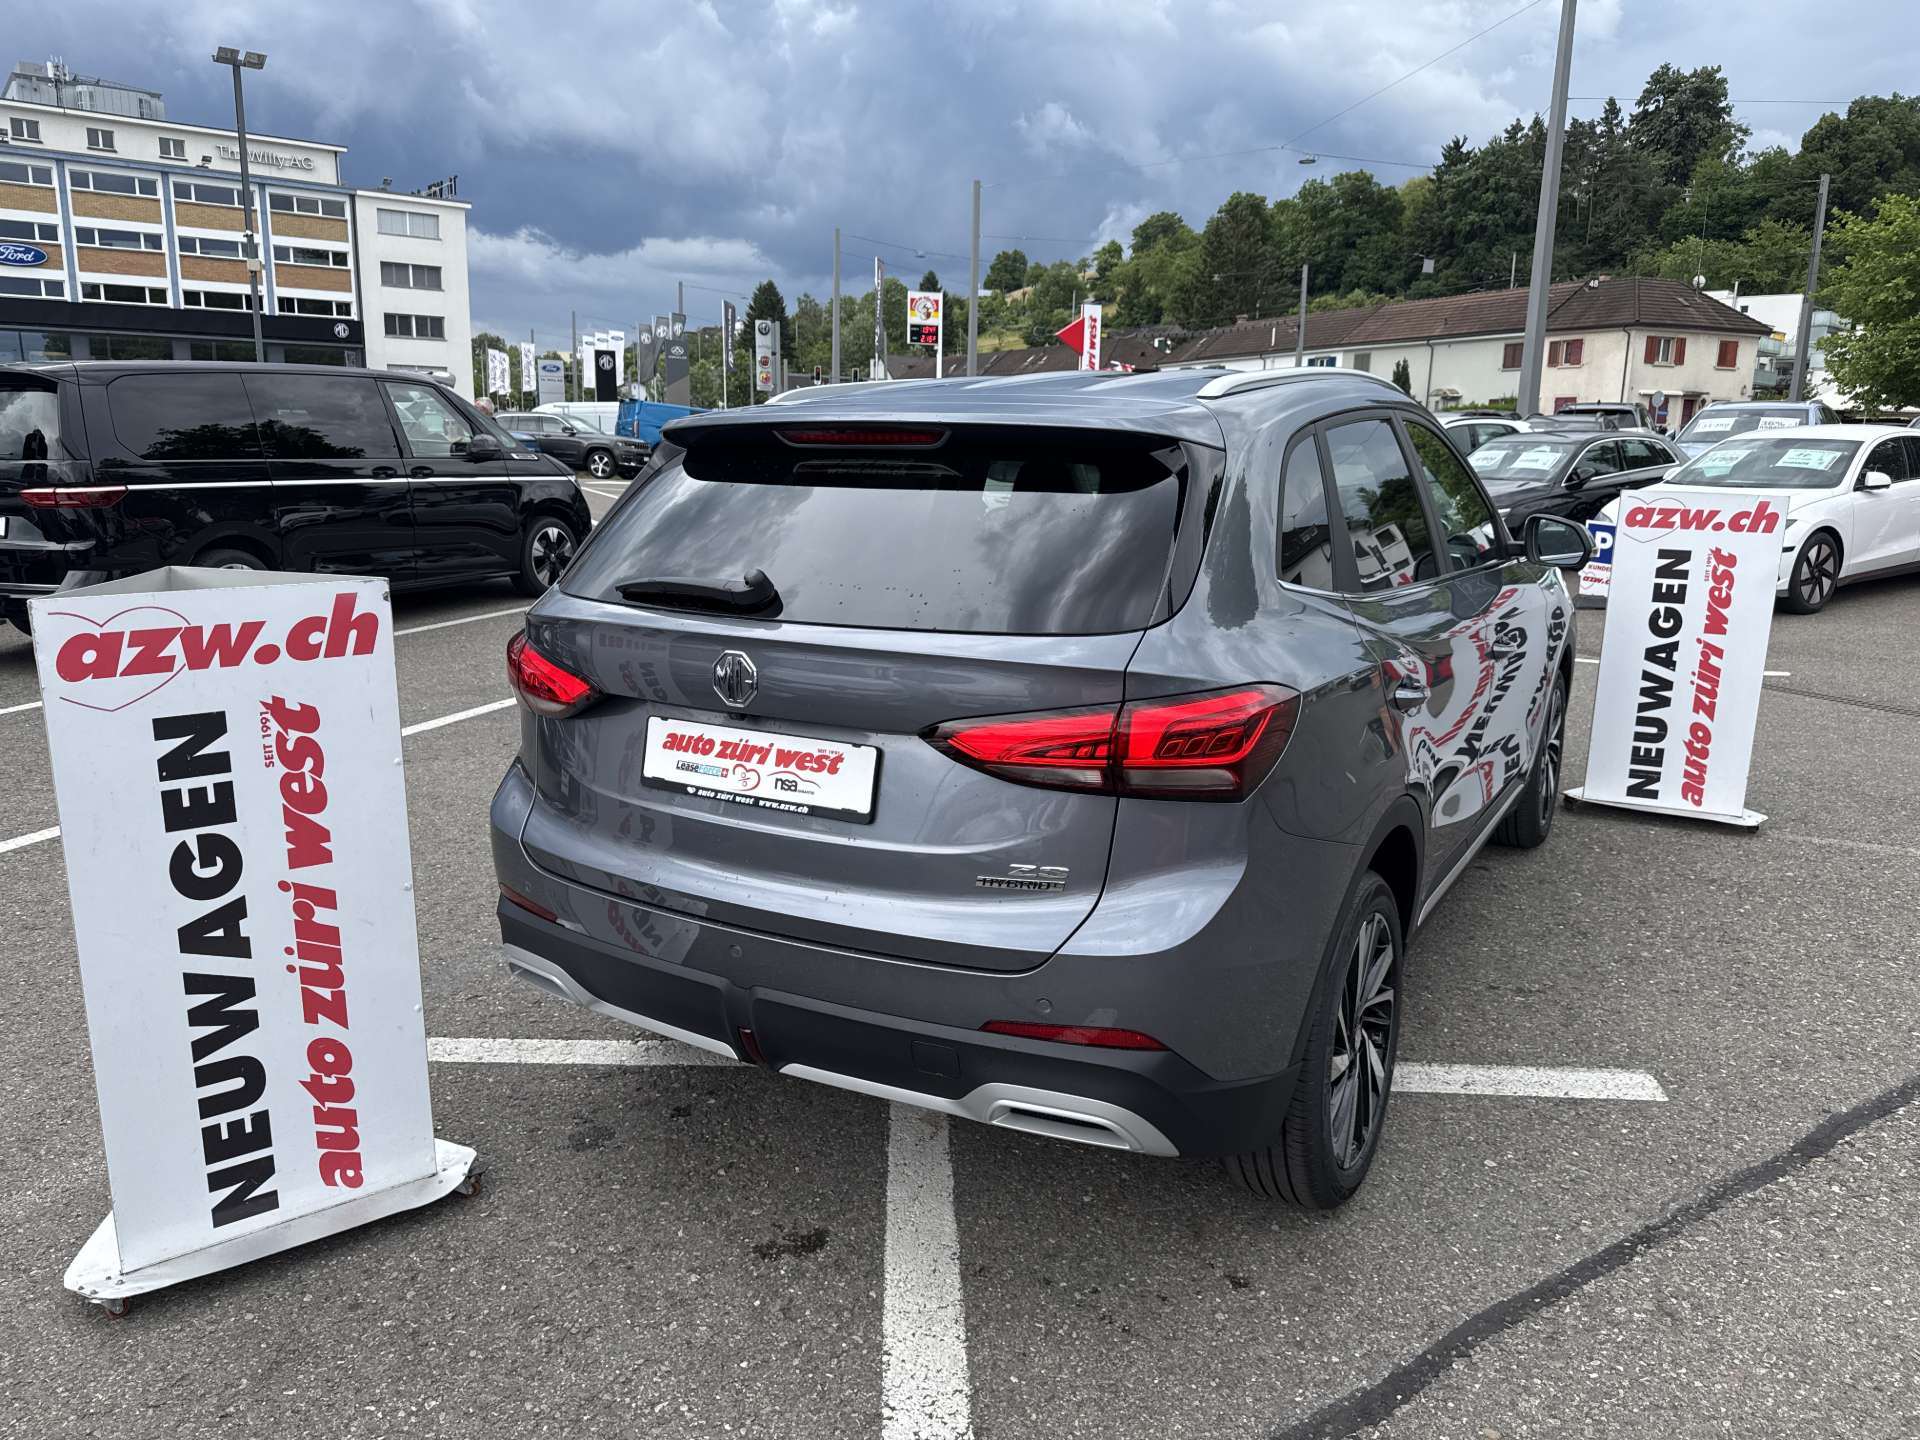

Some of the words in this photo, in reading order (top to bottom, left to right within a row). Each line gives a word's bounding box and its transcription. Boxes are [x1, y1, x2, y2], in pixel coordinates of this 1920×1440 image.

[290, 153, 314, 170] AG
[0, 245, 35, 261] Ford
[334, 323, 350, 338] MG
[599, 354, 614, 370] MG
[1625, 501, 1780, 534] azw.ch
[1594, 531, 1613, 557] P
[1583, 576, 1610, 584] azw.c
[1588, 564, 1612, 572] KUNDE
[1703, 546, 1738, 636] west
[56, 592, 379, 682] azw.ch
[715, 655, 753, 702] MG
[1626, 548, 1692, 800] NEUWAGEN
[1690, 637, 1724, 723] züri
[259, 711, 271, 739] 1991
[263, 744, 275, 768] SEIT
[662, 733, 715, 756] auto
[714, 738, 774, 766] züri
[775, 748, 845, 775] west
[1681, 720, 1712, 807] auto
[259, 695, 333, 870] west
[775, 778, 798, 793] nsa
[698, 788, 714, 798] auto
[717, 791, 733, 801] züri
[735, 795, 754, 804] west
[759, 799, 809, 814] www.azw.ch
[1008, 863, 1069, 879] ZS
[152, 710, 280, 1228] NEUWAGEN
[277, 880, 349, 1029] züri
[298, 1037, 364, 1189] auto
